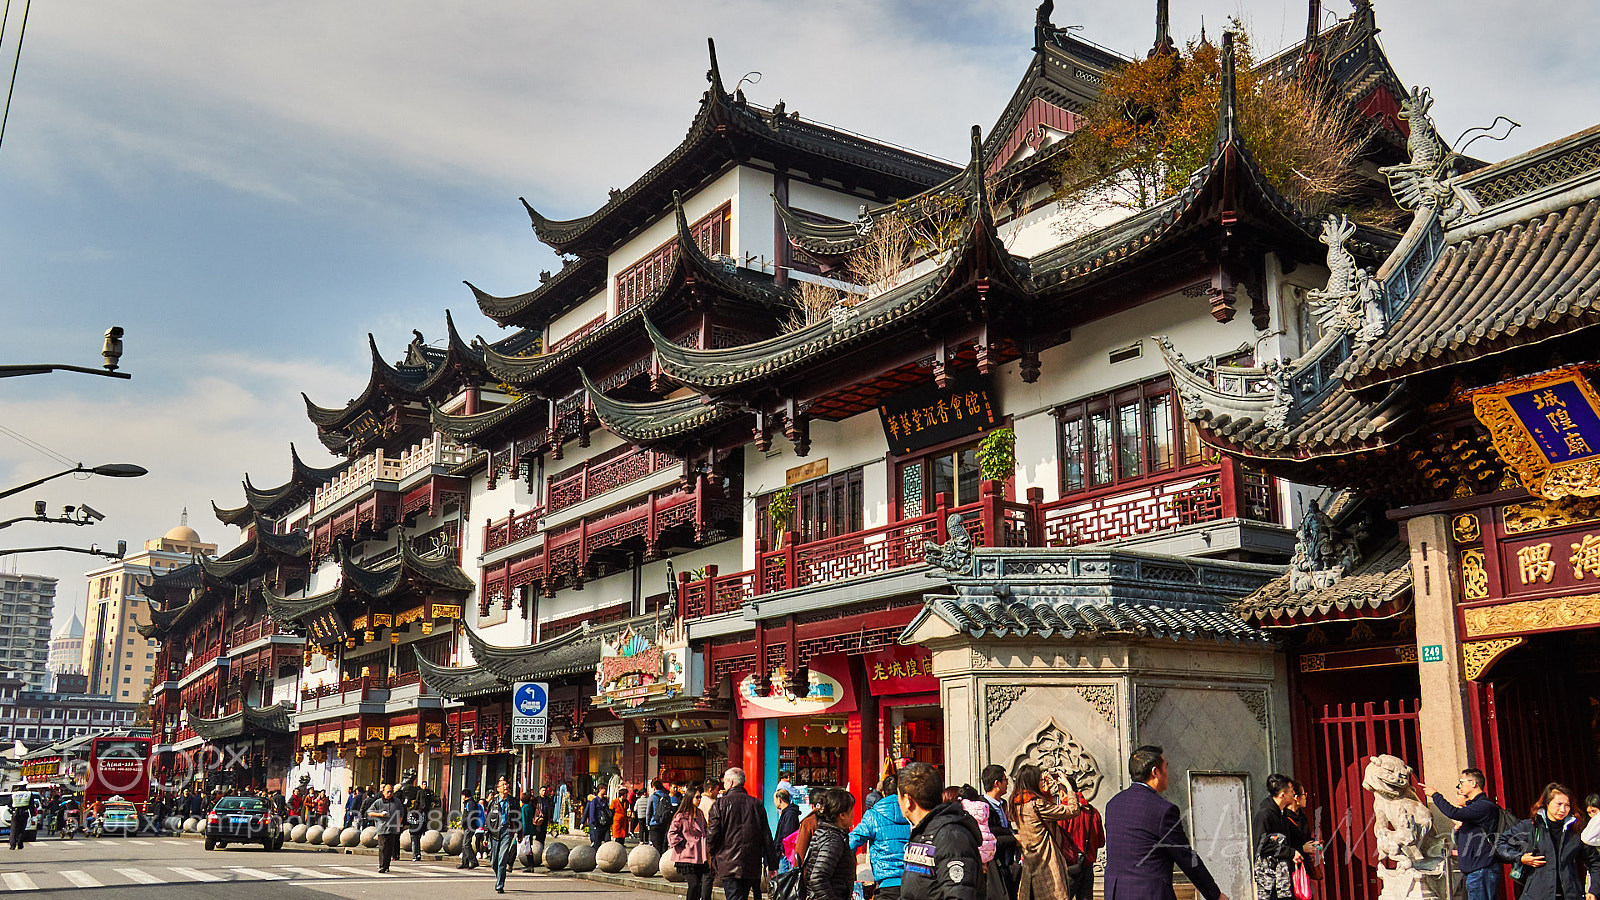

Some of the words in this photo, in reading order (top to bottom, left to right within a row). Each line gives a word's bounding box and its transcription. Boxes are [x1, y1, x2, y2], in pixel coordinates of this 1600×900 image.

[1533, 389, 1593, 456] 城隍廟
[1424, 646, 1440, 656] 249
